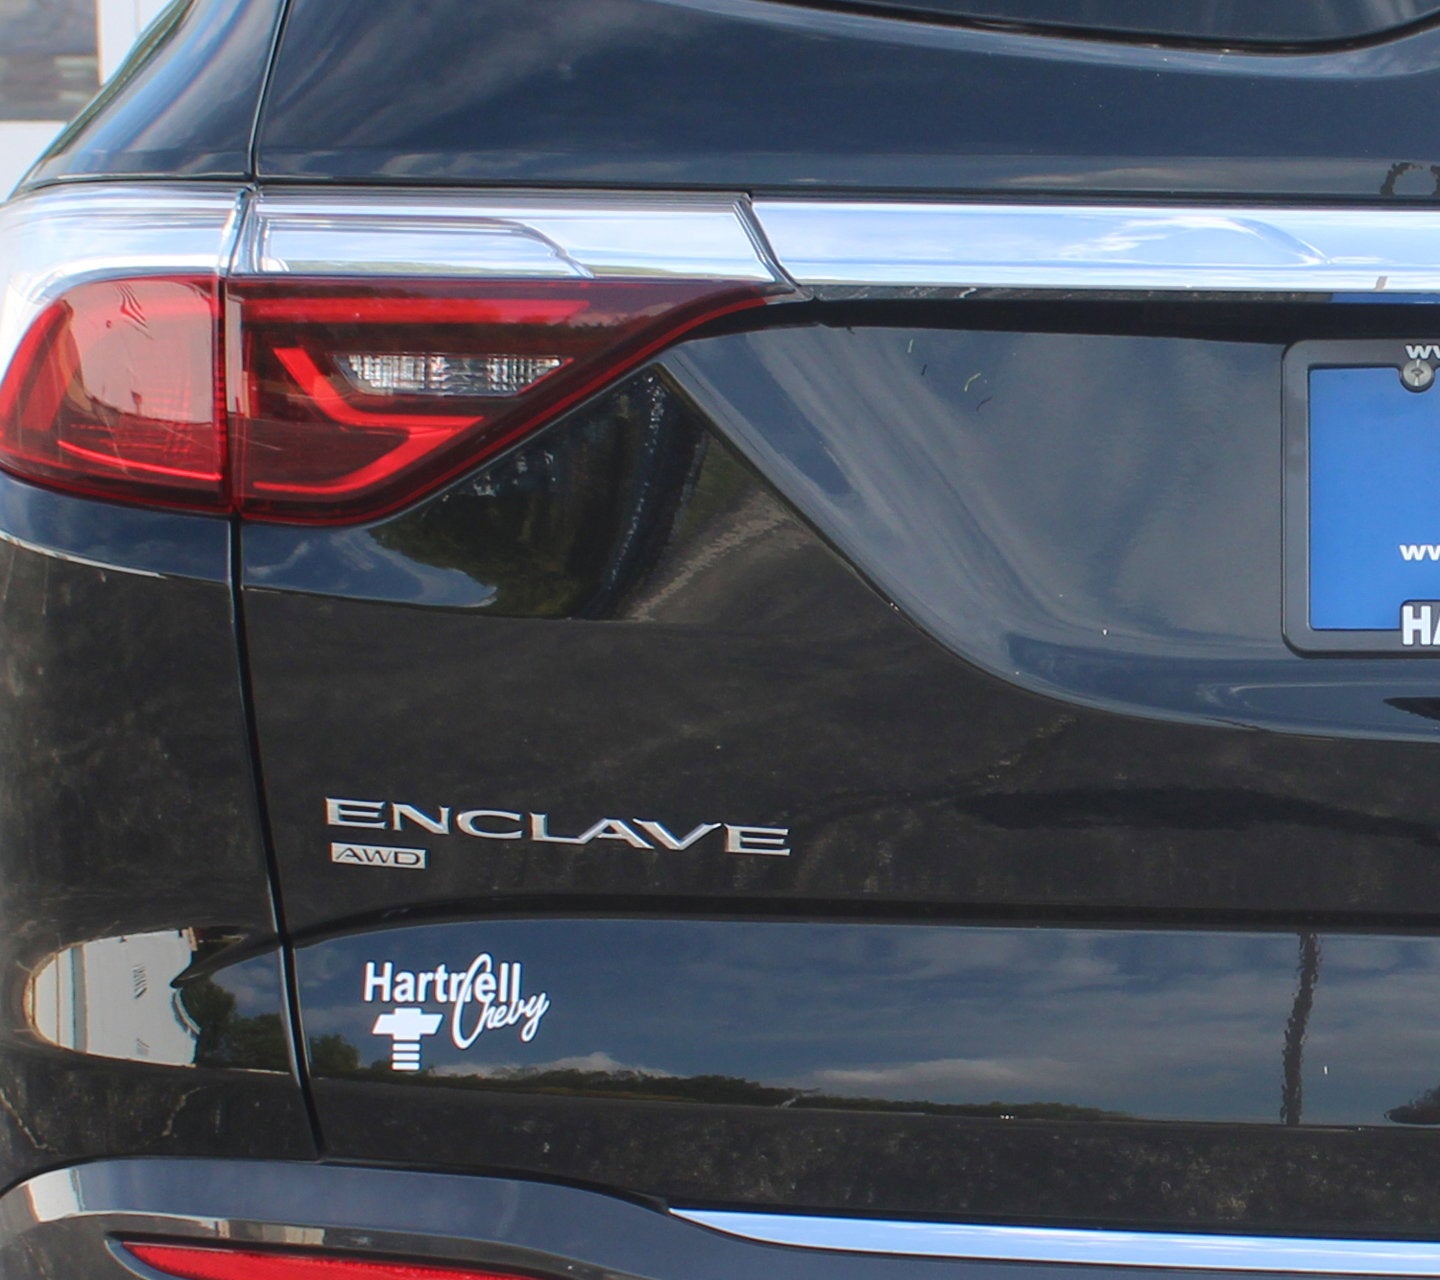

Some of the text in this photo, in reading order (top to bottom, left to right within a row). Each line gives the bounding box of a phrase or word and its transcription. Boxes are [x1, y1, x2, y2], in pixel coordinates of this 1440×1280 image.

[325, 797, 791, 856] ENCLAVE
[335, 846, 422, 867] AWD
[364, 960, 522, 1004] Hartnell
[452, 953, 550, 1049] Chevy
